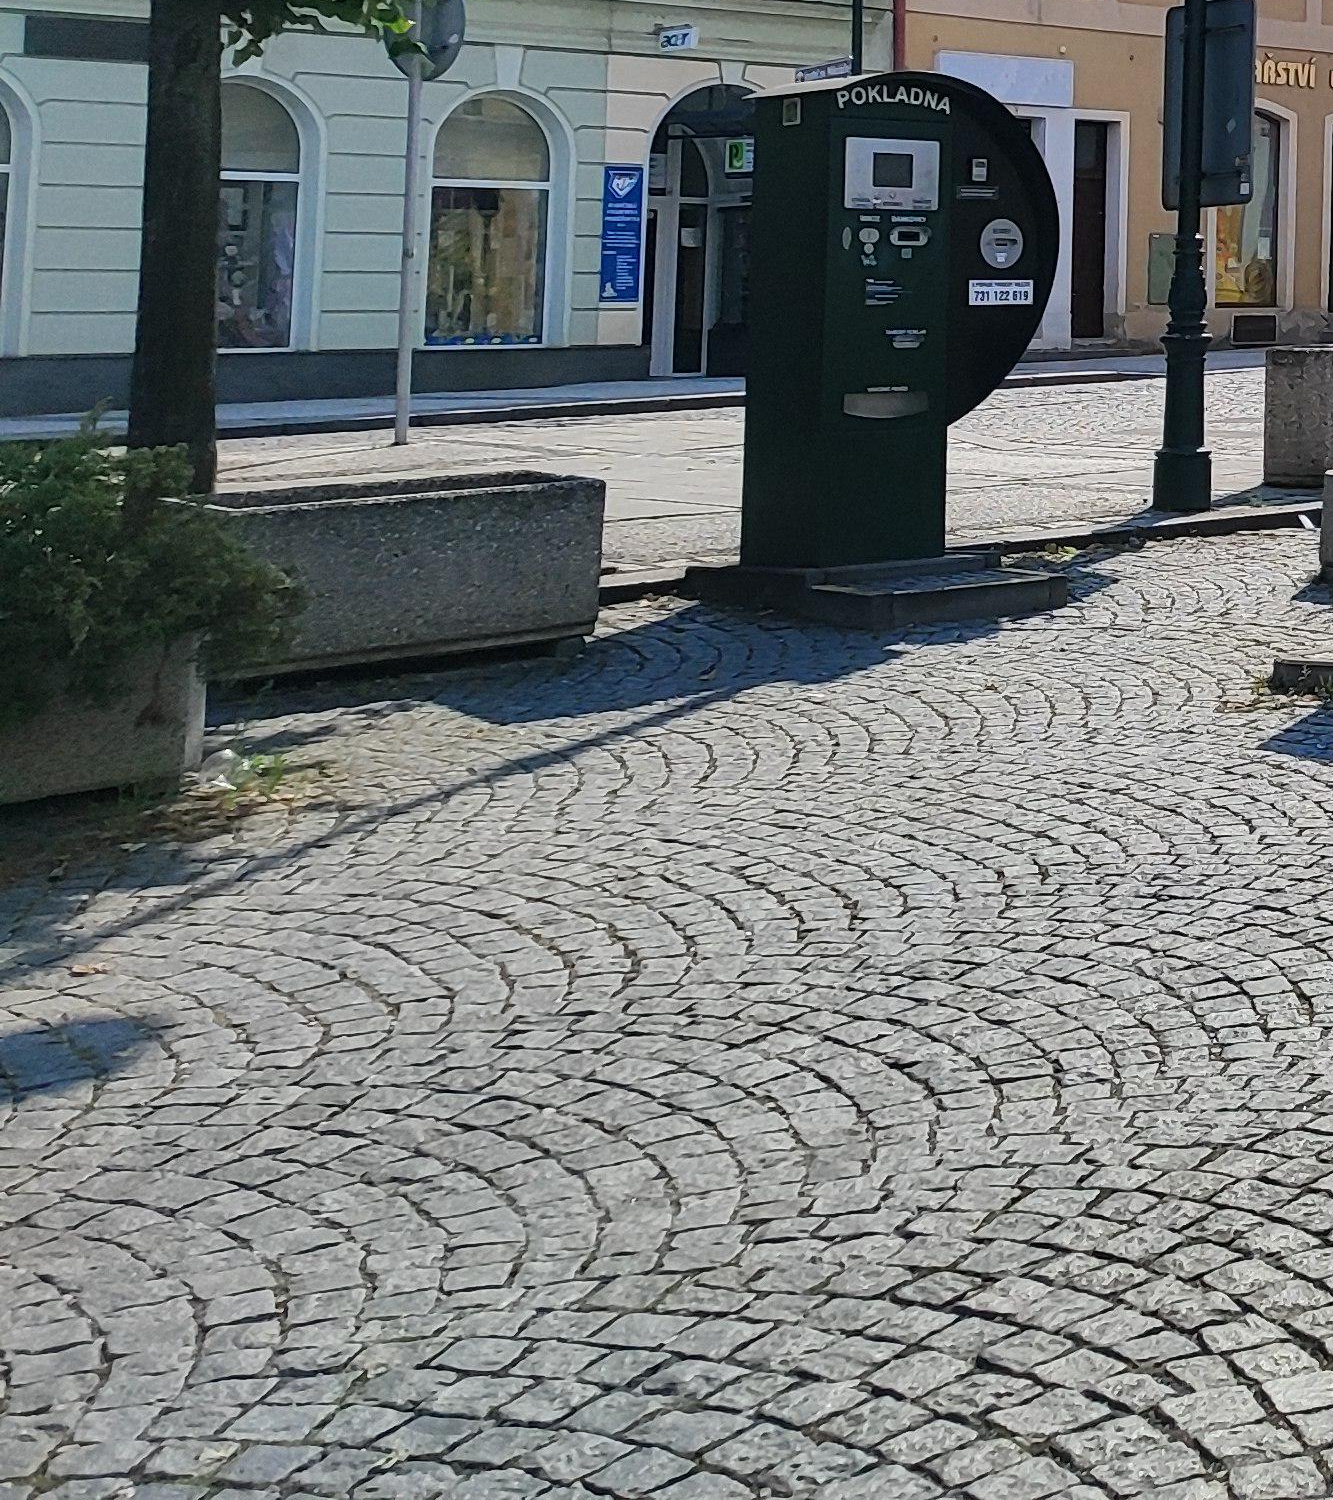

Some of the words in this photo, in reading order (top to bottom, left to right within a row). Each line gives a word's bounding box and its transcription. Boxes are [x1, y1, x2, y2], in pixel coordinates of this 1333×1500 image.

[660, 31, 690, 49] acer
[835, 84, 951, 115] POKLADNA
[973, 290, 990, 302] 731
[993, 290, 1010, 302] 122
